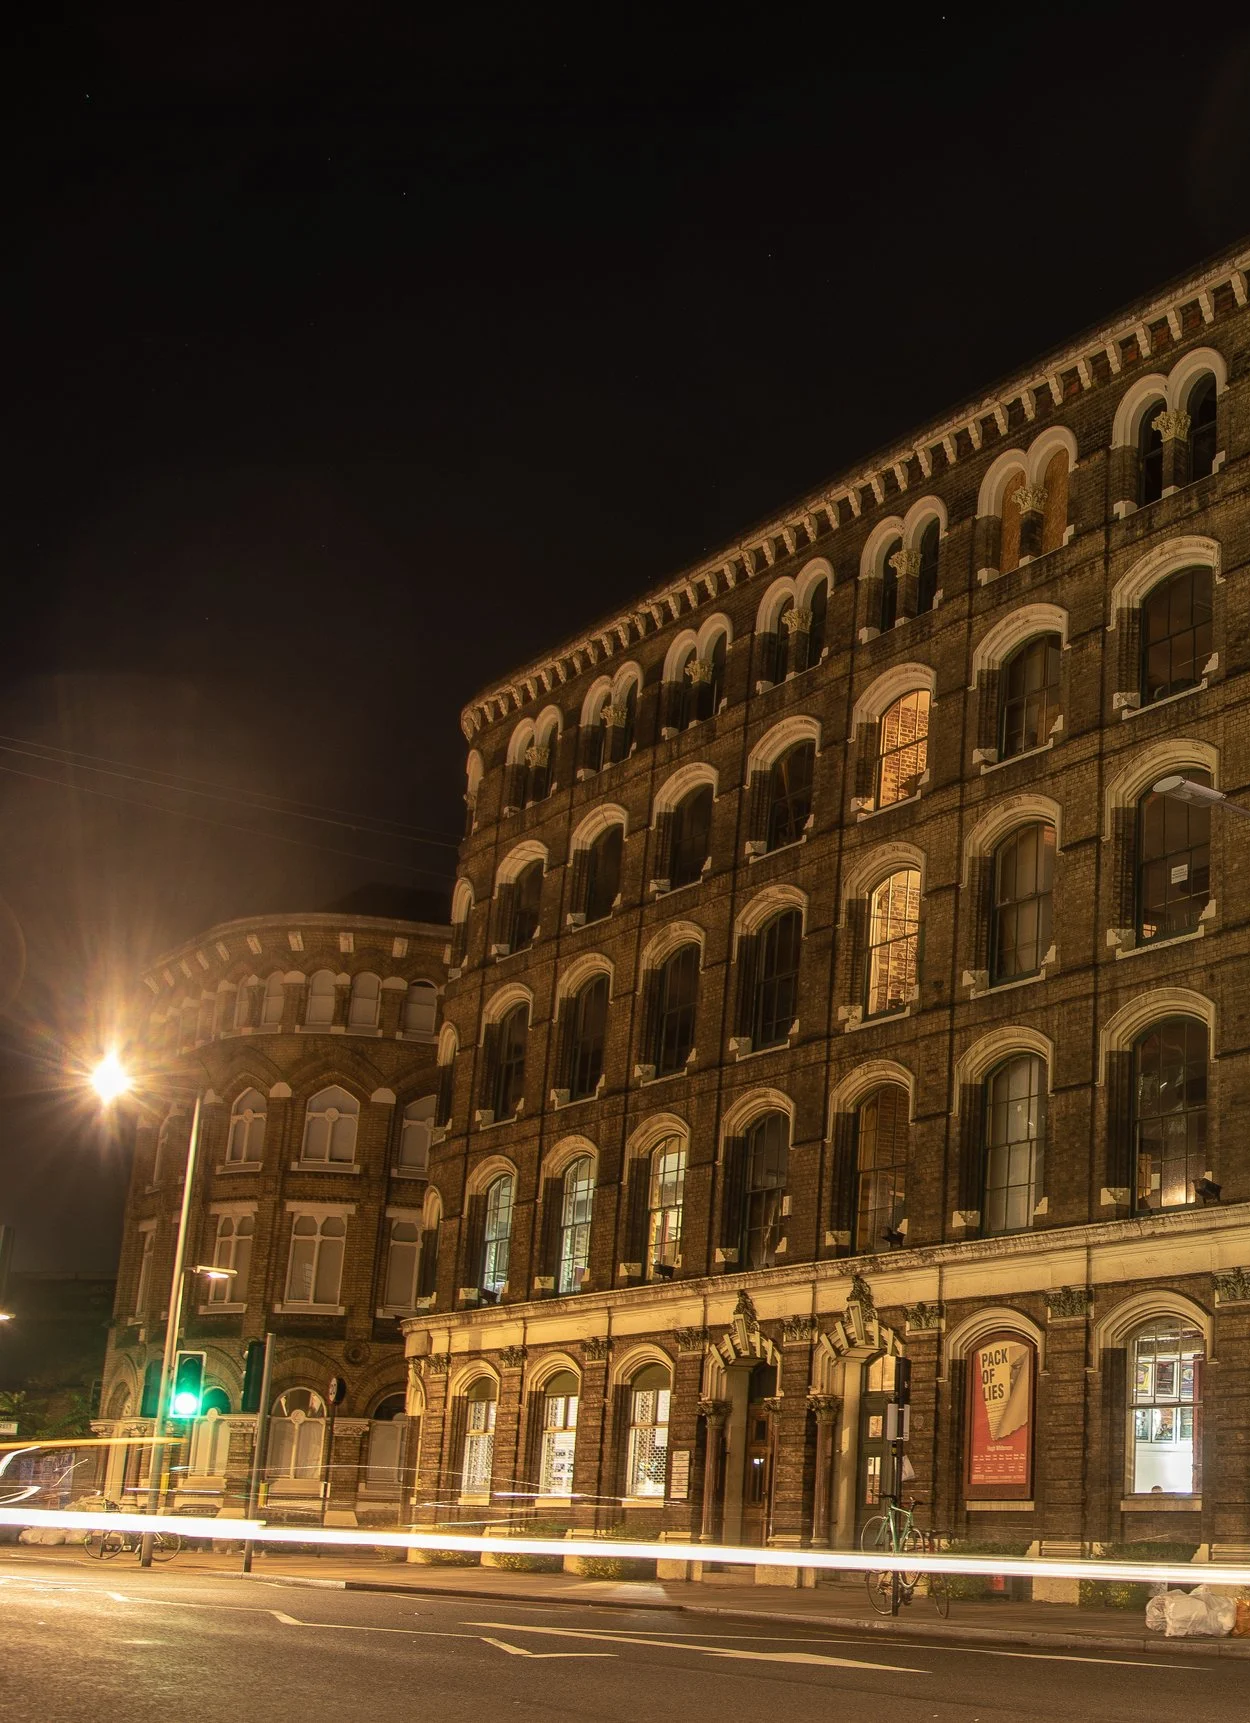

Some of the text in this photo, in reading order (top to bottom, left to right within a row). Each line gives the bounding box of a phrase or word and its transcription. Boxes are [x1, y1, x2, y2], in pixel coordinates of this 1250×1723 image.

[982, 1348, 1008, 1368] PACK
[982, 1368, 995, 1385] OF
[983, 1383, 1004, 1401] LIES
